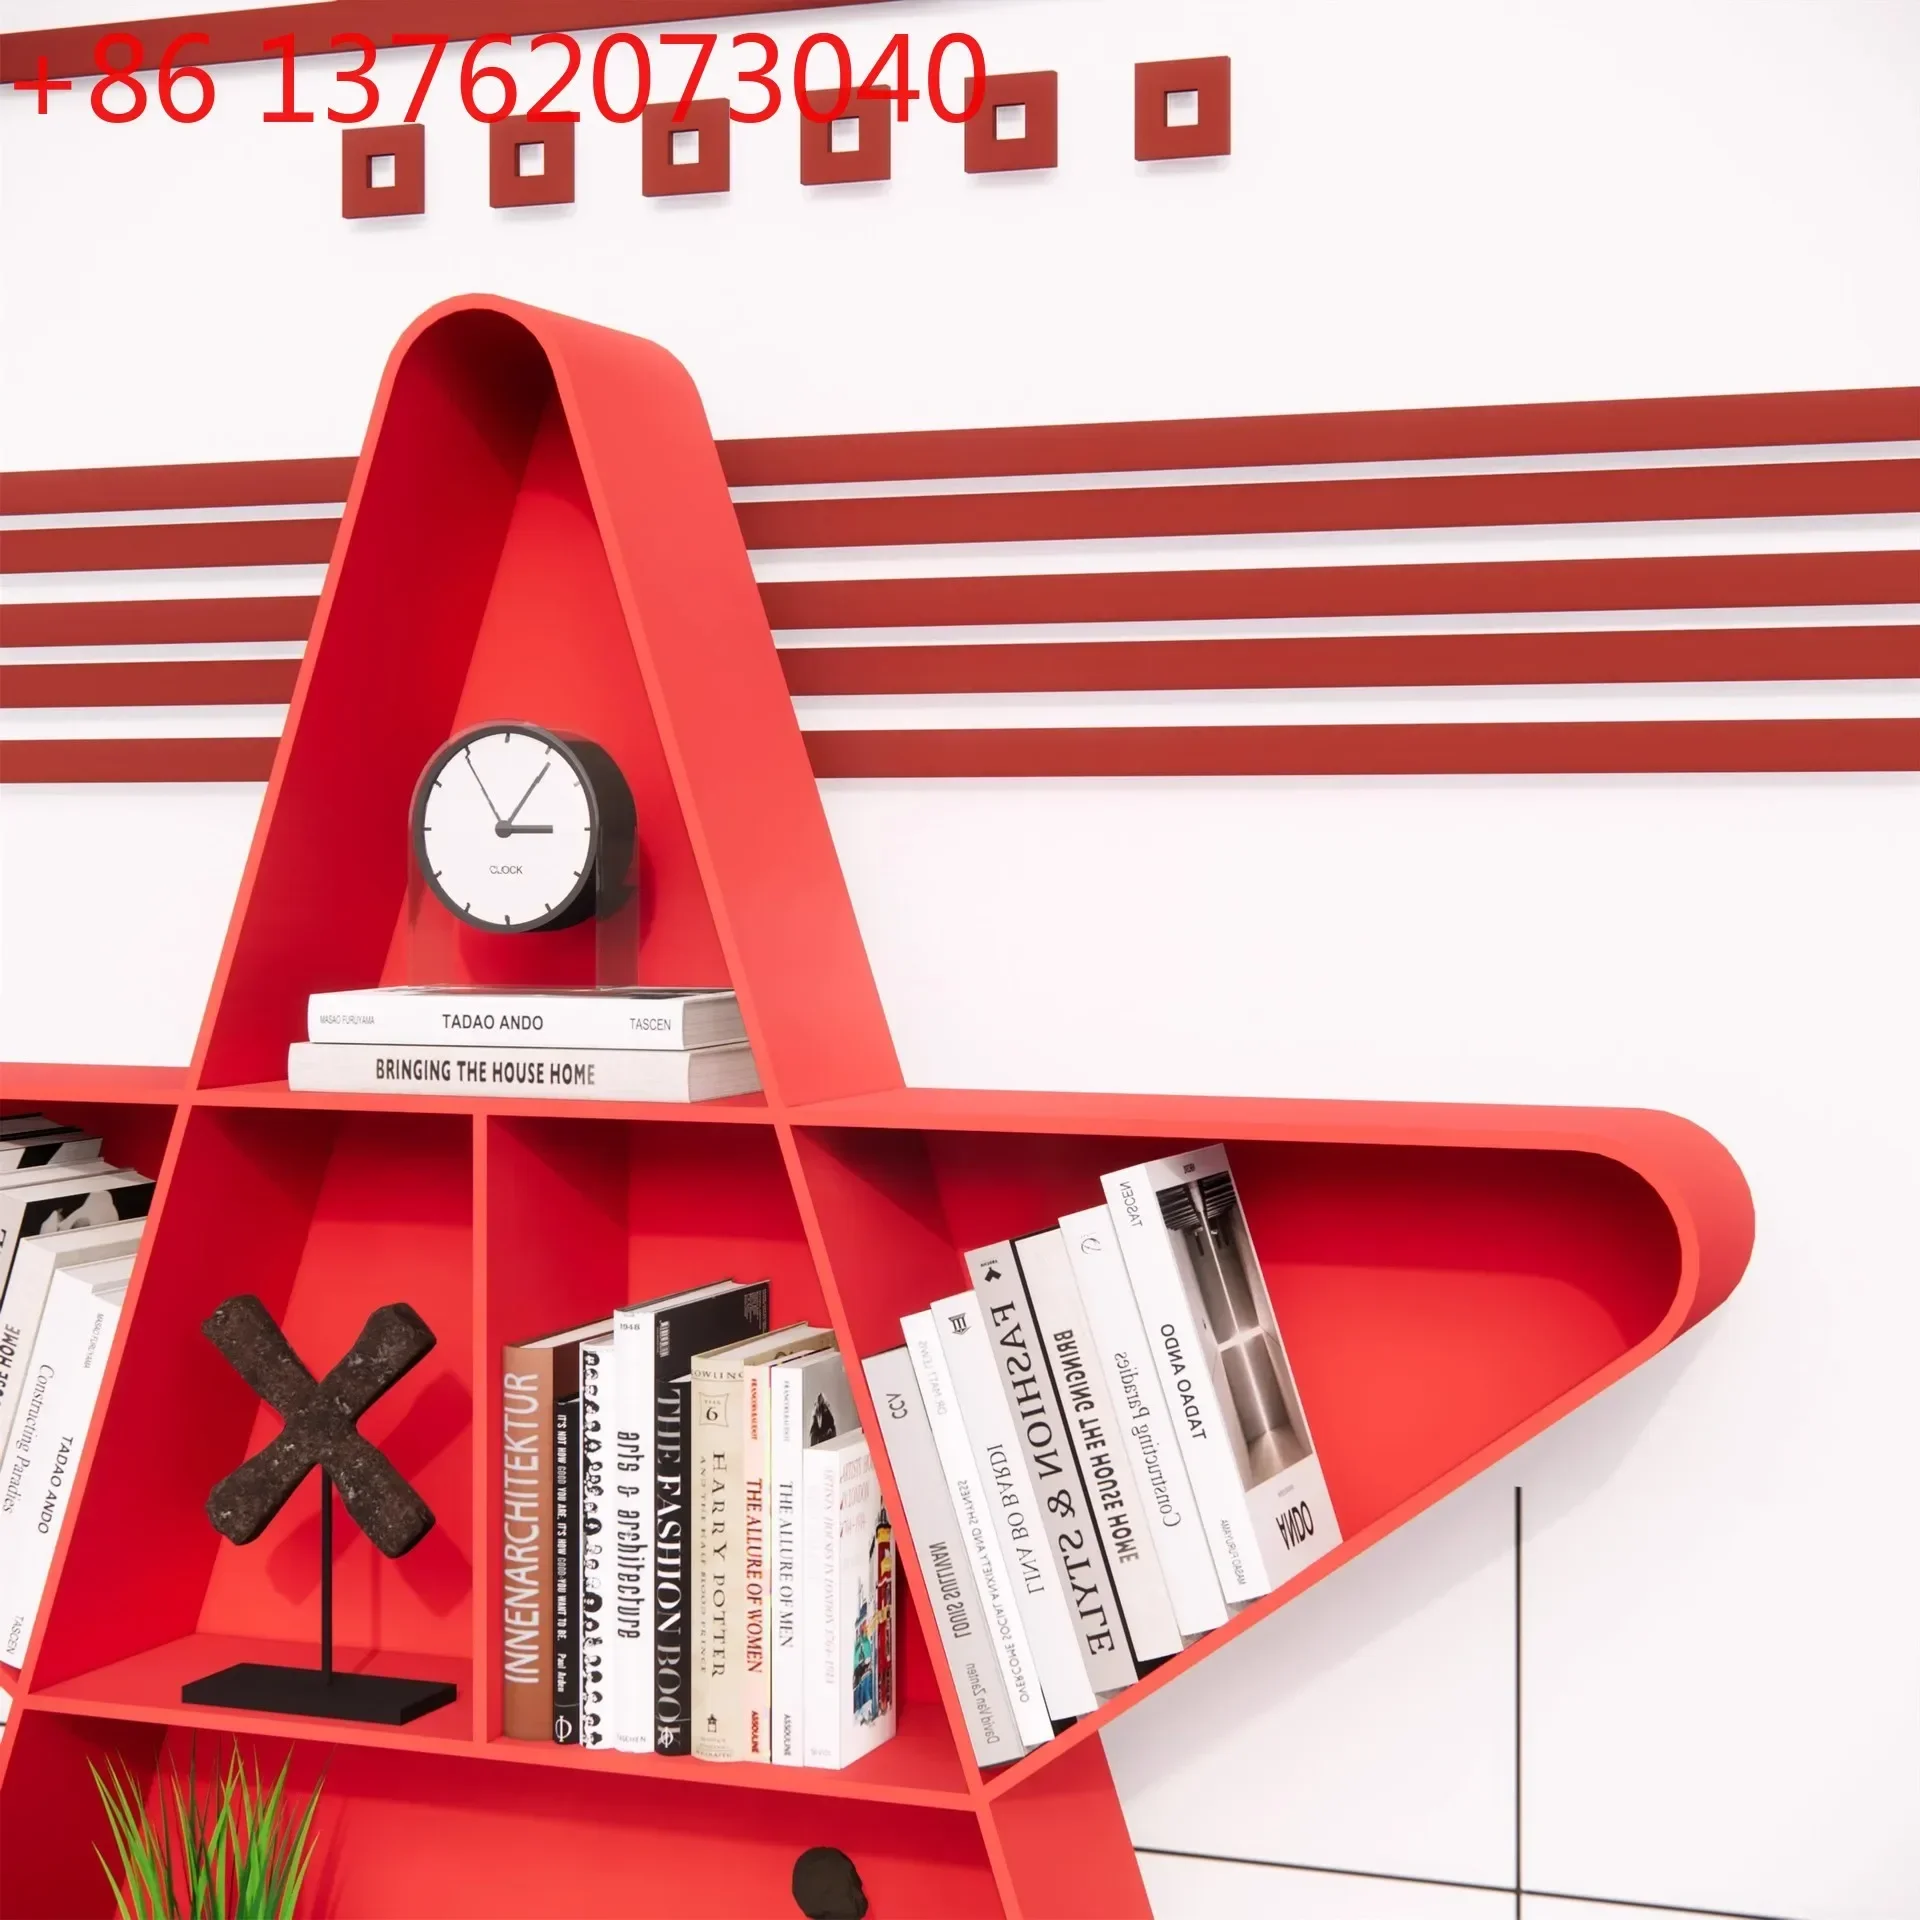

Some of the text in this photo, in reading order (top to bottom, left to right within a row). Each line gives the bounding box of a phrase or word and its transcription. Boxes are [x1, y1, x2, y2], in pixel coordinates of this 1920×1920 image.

[489, 865, 523, 875] CLOCK
[442, 1014, 544, 1031] TADAO ANDO
[630, 1018, 671, 1031] TASCEN
[376, 1058, 595, 1085] BRINGING THE HOUSE HOME
[557, 1414, 567, 1428] IT'S
[706, 1407, 719, 1421] 6
[3, 1364, 55, 1513] Constructing Paradies
[557, 1431, 567, 1445] NOT
[557, 1447, 567, 1464] HOW
[618, 1431, 645, 1472] arts
[38, 1436, 73, 1534] TADAO ANDO
[557, 1466, 567, 1484] GOOD
[557, 1487, 567, 1501] YOU
[504, 1373, 539, 1684] INNENARCHITEKTUR
[557, 1522, 567, 1536] IT'S
[557, 1538, 567, 1555] HOW
[618, 1510, 648, 1639] architecture
[657, 1388, 681, 1747] THE FASHION BOOK
[711, 1451, 728, 1678] HARRY POTTER
[779, 1482, 794, 1648] THE ALLURE OF MEN
[746, 1478, 763, 1673] THE ALLURE OF WOMEN
[557, 1579, 567, 1593] YOU
[557, 1595, 567, 1615] WANT
[557, 1618, 567, 1627] TO
[6, 1616, 24, 1655] TASCEN
[557, 1629, 567, 1641] BE.
[557, 1653, 567, 1692] Paul Arden
[751, 1710, 760, 1754] ASSOULINE
[783, 1714, 791, 1757] ASSOULINE
